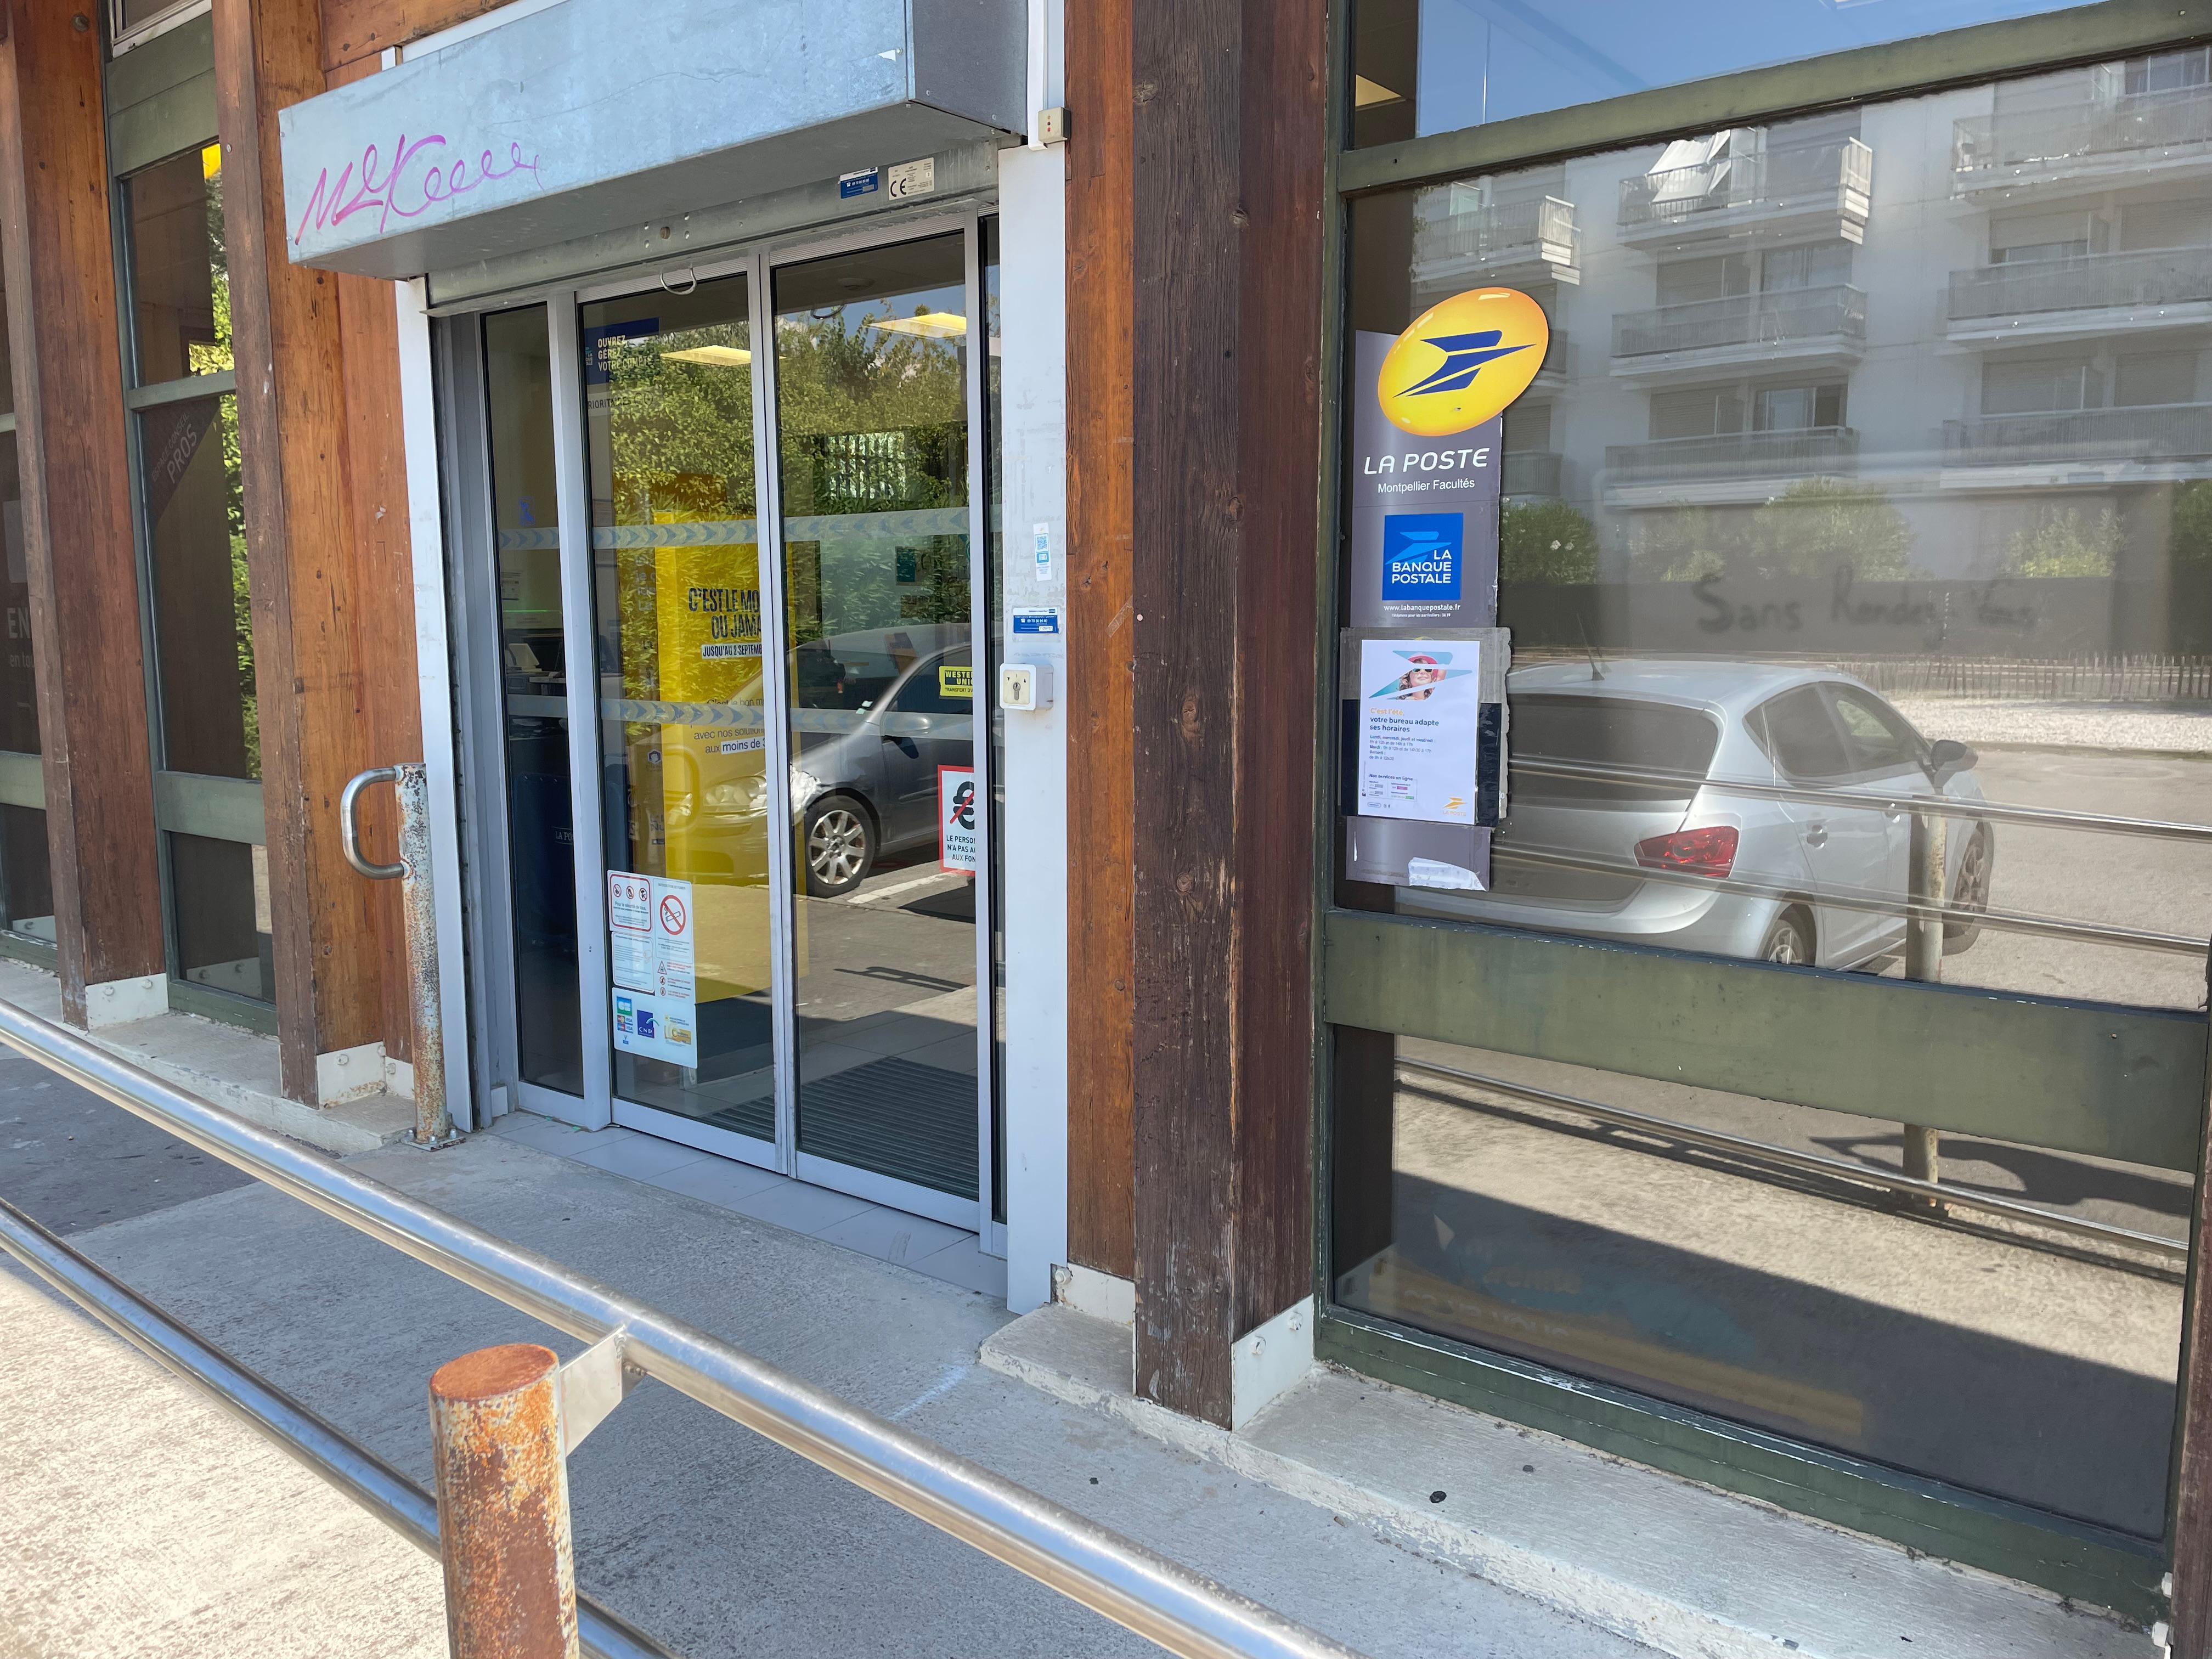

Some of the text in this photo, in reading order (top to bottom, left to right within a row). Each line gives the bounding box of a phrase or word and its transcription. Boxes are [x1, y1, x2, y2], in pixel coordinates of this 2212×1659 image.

[167, 424, 197, 484] PROS
[1364, 447, 1490, 475] LA POSTE
[1378, 478, 1475, 494] Montpellier Facultés
[1434, 550, 1452, 560] LA
[1392, 561, 1452, 572] BANQUE
[1392, 573, 1451, 584] POSTALE
[689, 588, 723, 612] C'EST
[725, 589, 738, 612] LE
[1692, 571, 1803, 634] Sans
[1384, 603, 1461, 612] www.labanquepostale.fr
[711, 614, 729, 639] OU
[703, 645, 732, 657] JUSQU'AU
[733, 645, 737, 656] 2
[755, 698, 764, 706] m
[694, 731, 715, 740] avec
[718, 729, 733, 738] nos
[705, 738, 760, 754] aux moins de
